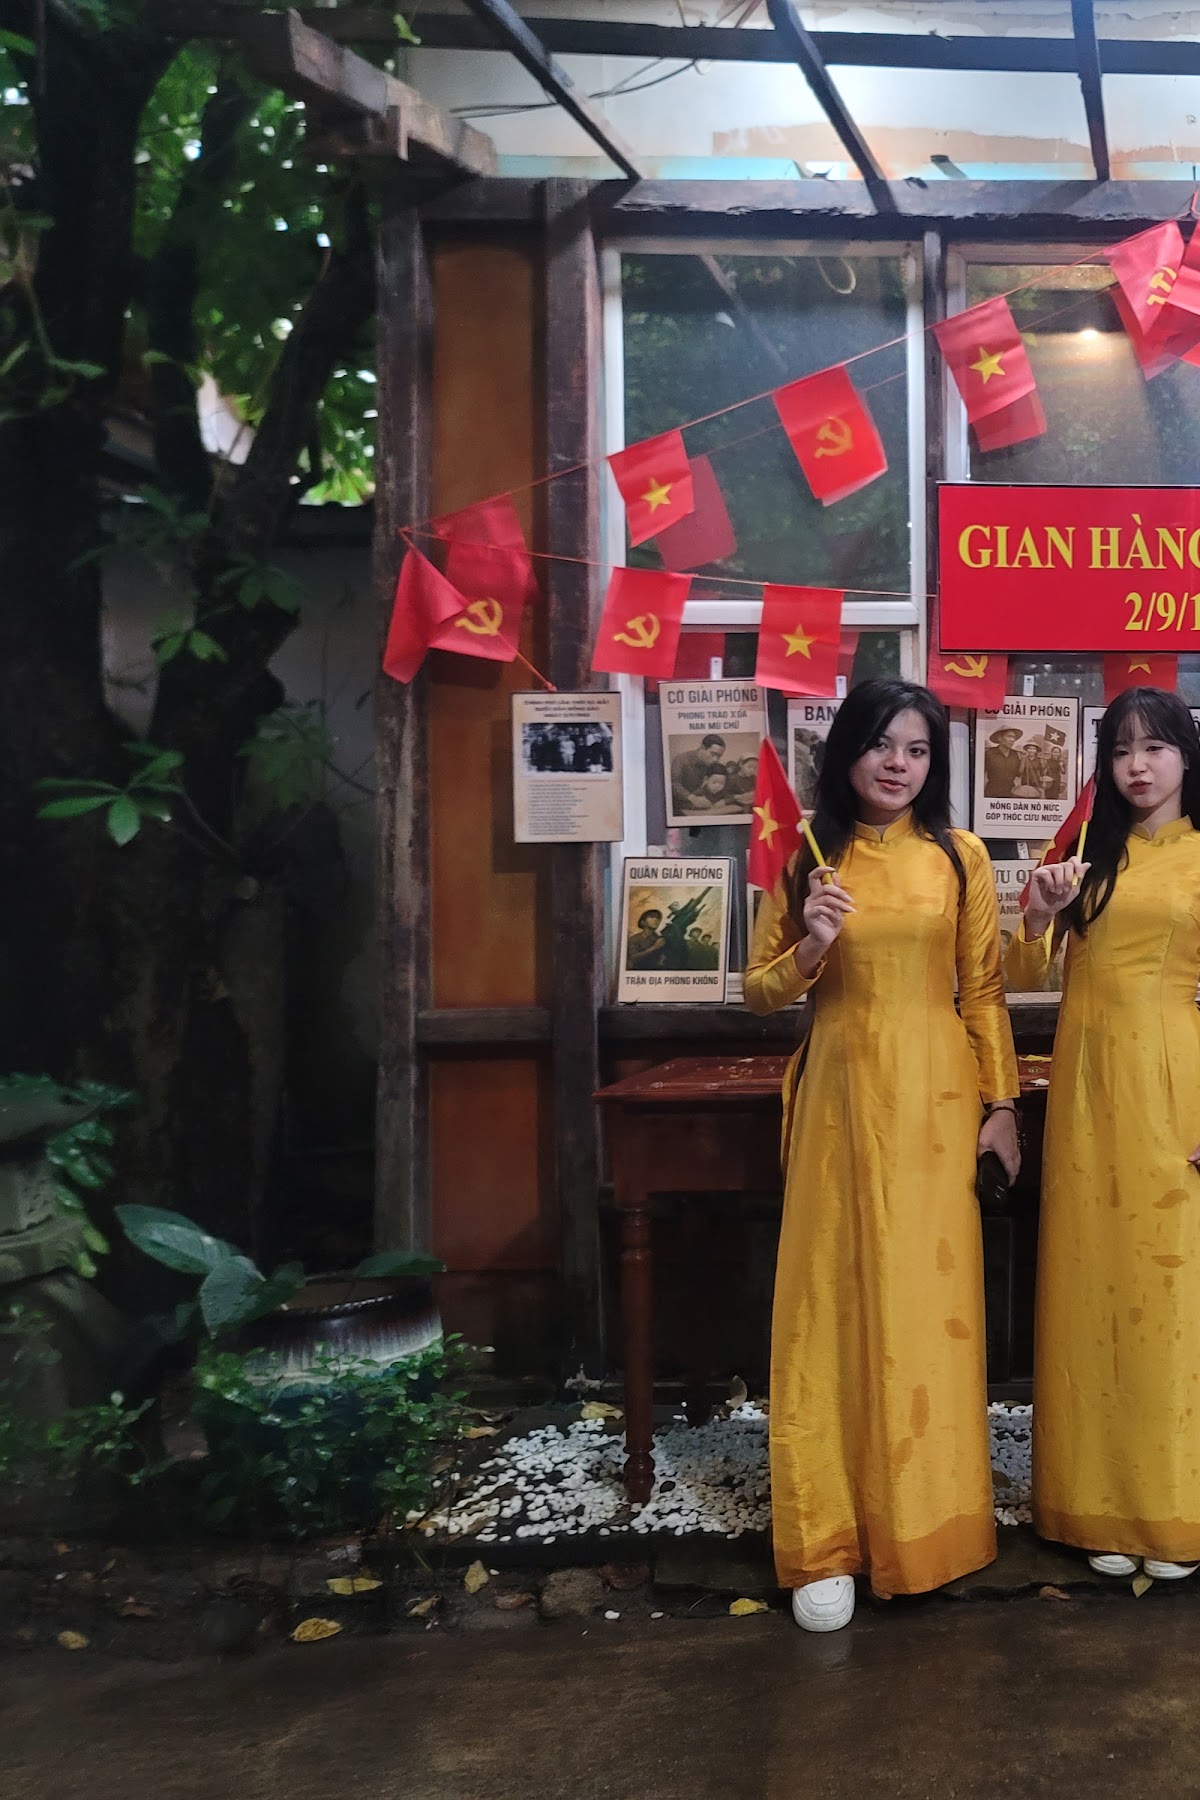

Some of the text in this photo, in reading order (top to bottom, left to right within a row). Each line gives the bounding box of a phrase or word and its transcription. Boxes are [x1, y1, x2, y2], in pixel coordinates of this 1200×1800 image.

[957, 525, 1075, 569] GIAN
[688, 685, 713, 703] GIẢI
[716, 686, 759, 702] PHÓNG
[1003, 700, 1071, 717] GIẢI PHÓNG
[661, 863, 683, 880] GIẢI
[685, 864, 723, 880] PHÓNG
